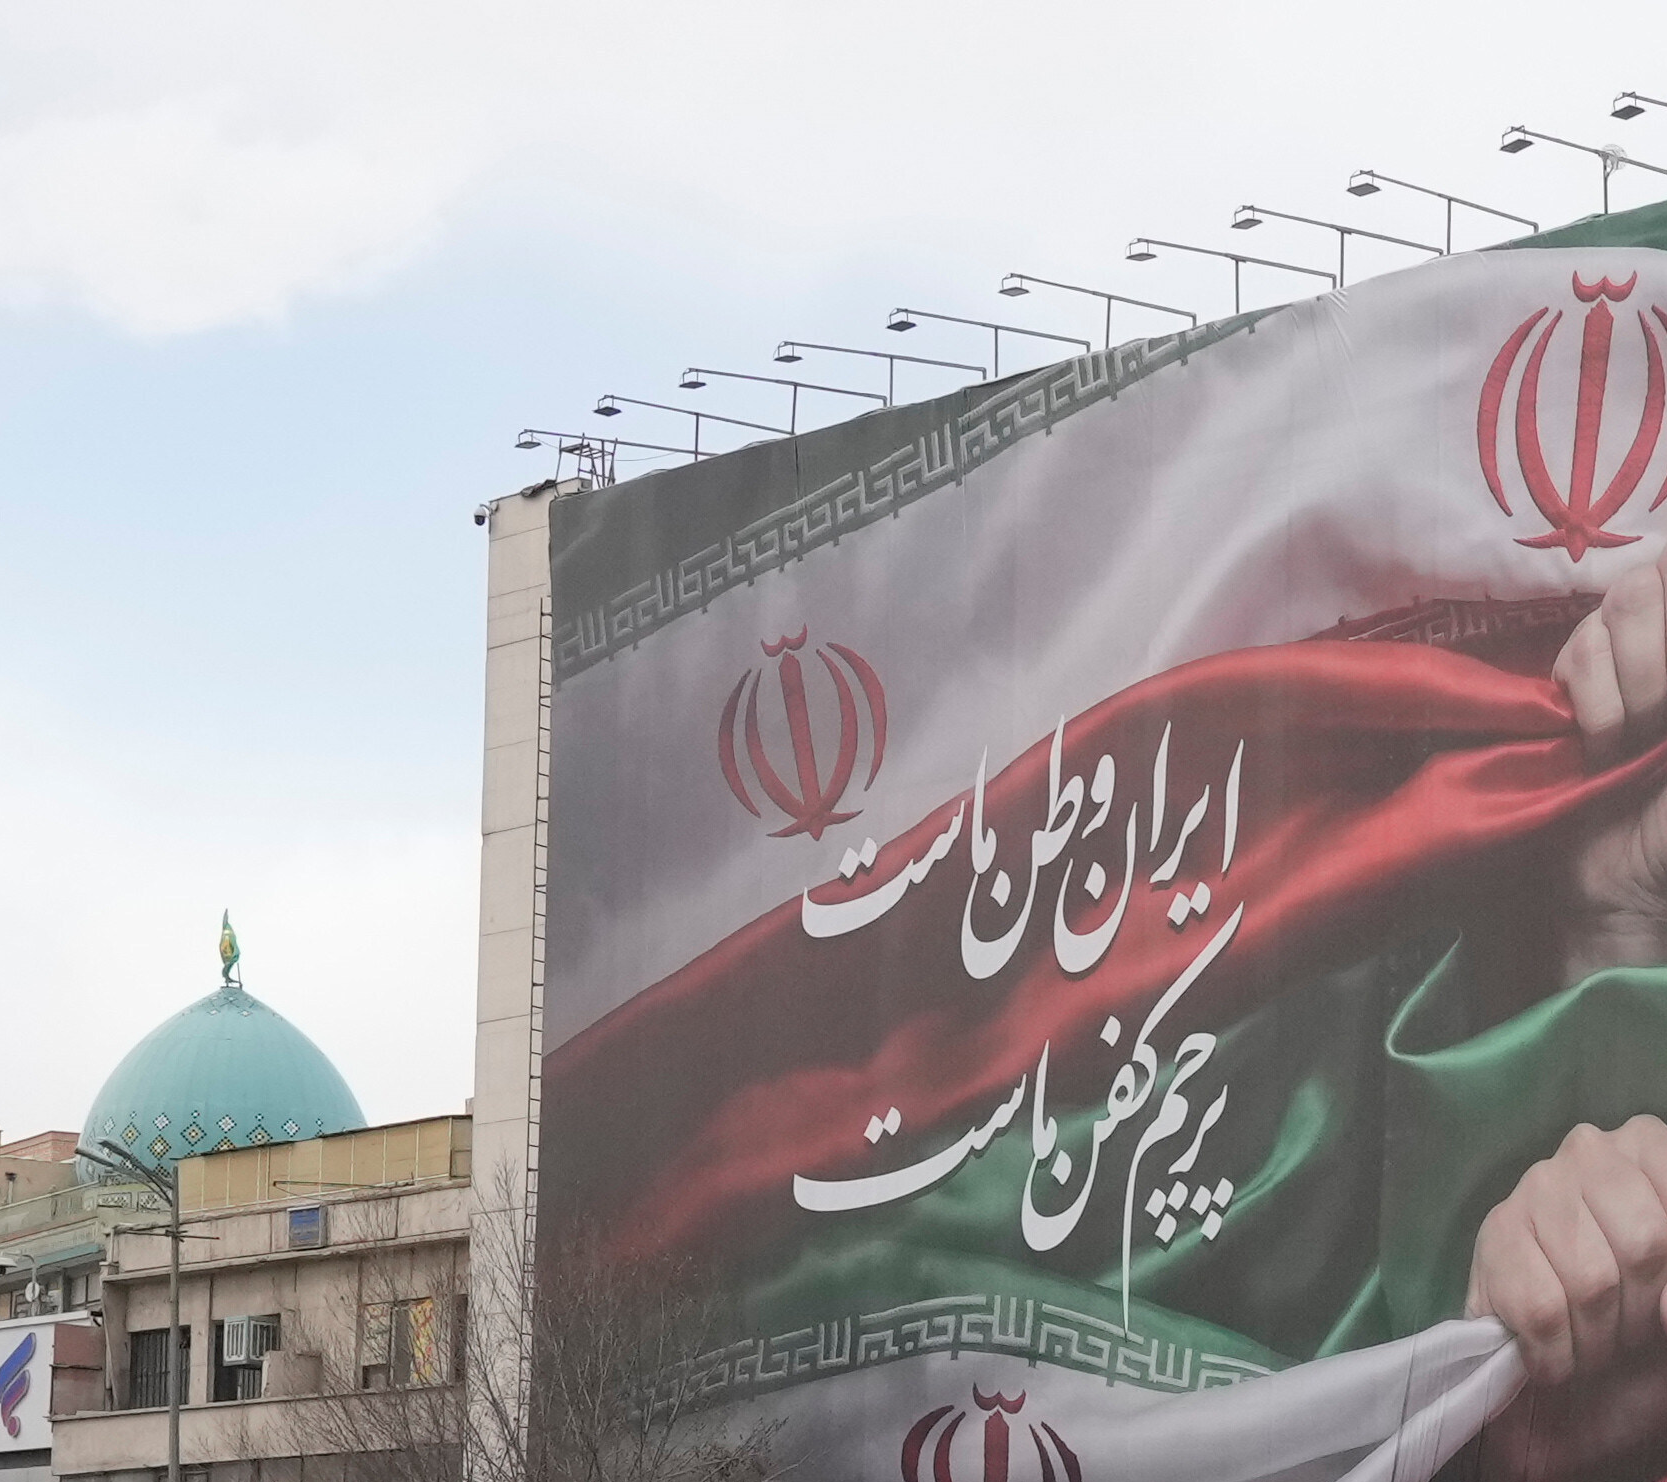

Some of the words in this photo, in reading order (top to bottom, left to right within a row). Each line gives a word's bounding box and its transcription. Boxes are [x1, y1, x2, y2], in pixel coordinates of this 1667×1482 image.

[801, 744, 997, 938] ماست
[961, 714, 1115, 979] وطن
[1053, 719, 1244, 973] ایران
[793, 1038, 1057, 1212] ماست
[1021, 901, 1244, 1252] کفن
[1122, 1033, 1233, 1328] پرچم
